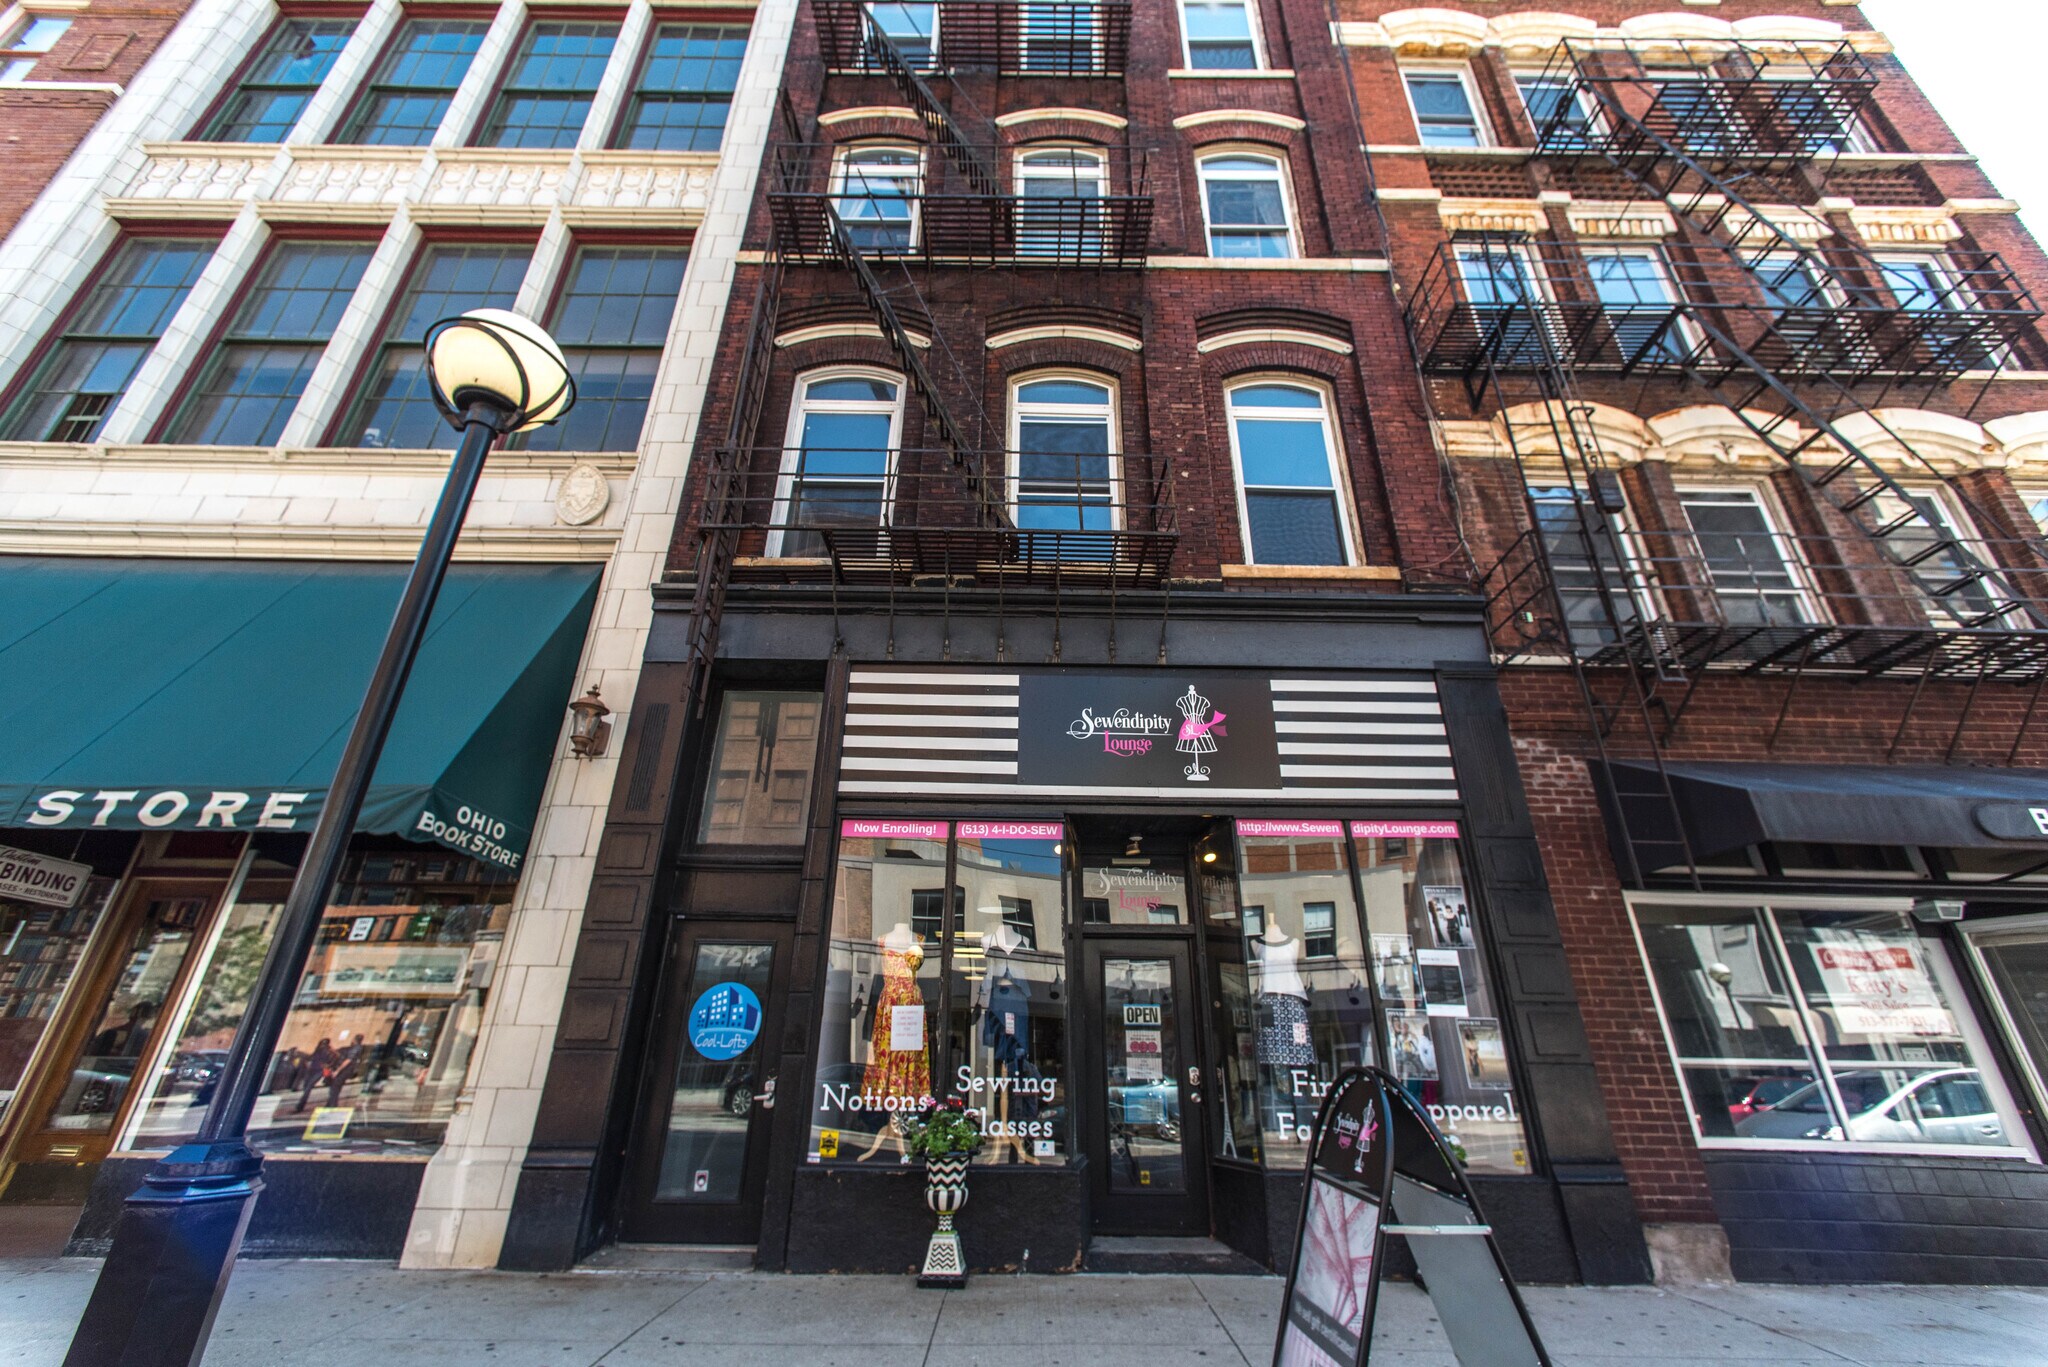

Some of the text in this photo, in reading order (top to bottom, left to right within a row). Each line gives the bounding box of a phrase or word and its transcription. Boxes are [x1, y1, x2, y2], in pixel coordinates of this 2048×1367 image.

[1070, 707, 1172, 739] Sewendipity
[1103, 730, 1152, 757] Lounge
[26, 790, 309, 829] STORE
[456, 806, 506, 840] OHIO
[853, 822, 937, 836] Now Enrolling!
[960, 824, 1058, 837] (513) 4-I-DO-SEW
[1239, 821, 1455, 836] http://www.Sewen dipityLounge.com
[0, 861, 77, 892] BINDING
[1090, 867, 1179, 897] Sewendipity
[714, 948, 759, 968] 724
[1846, 975, 1909, 998] Katy's
[1126, 1007, 1159, 1023] OPEN
[694, 1032, 748, 1050] Cool-Lofts
[956, 1065, 1058, 1102] Sewing
[820, 1083, 928, 1113] Notions
[1426, 1092, 1519, 1130] pparel
